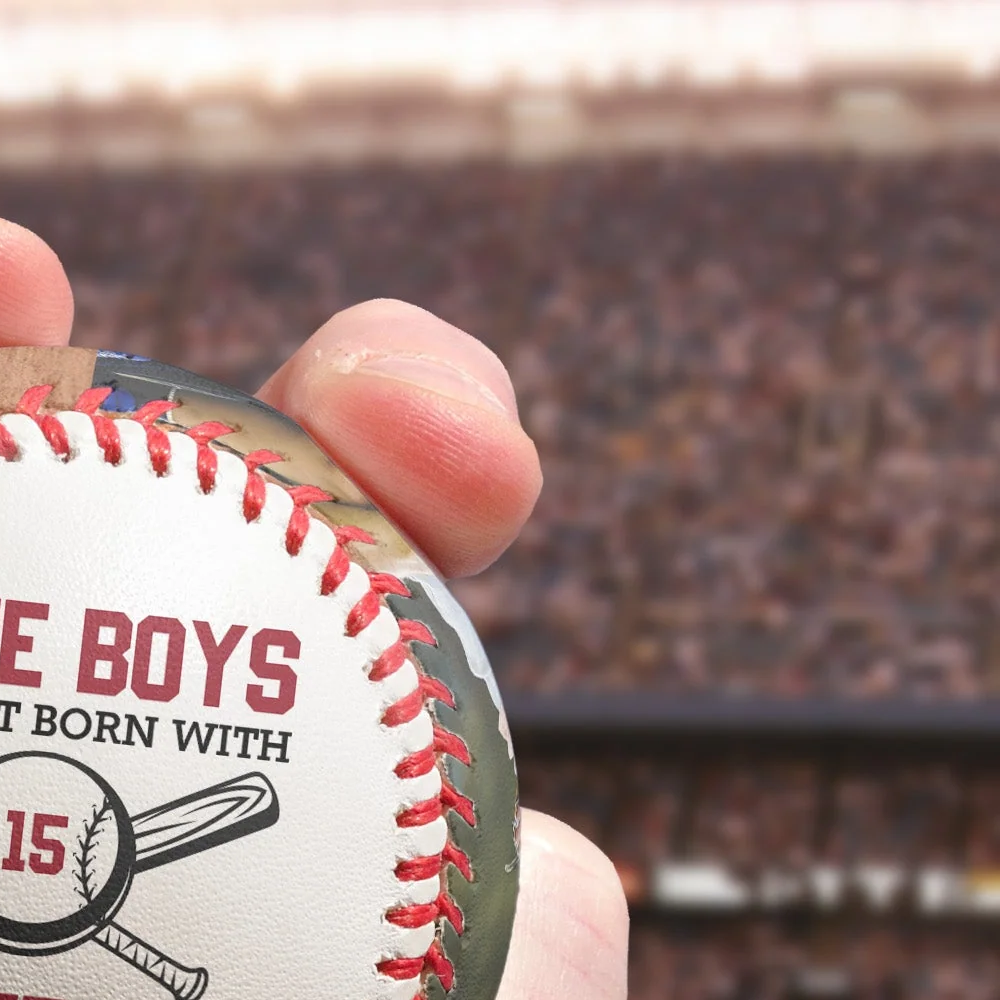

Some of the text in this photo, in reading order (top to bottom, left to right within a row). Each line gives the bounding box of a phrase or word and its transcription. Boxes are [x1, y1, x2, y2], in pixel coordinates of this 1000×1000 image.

[76, 608, 302, 715] BOYS
[31, 706, 160, 748] BORN
[172, 719, 293, 764] WITH
[1, 810, 69, 876] 15
